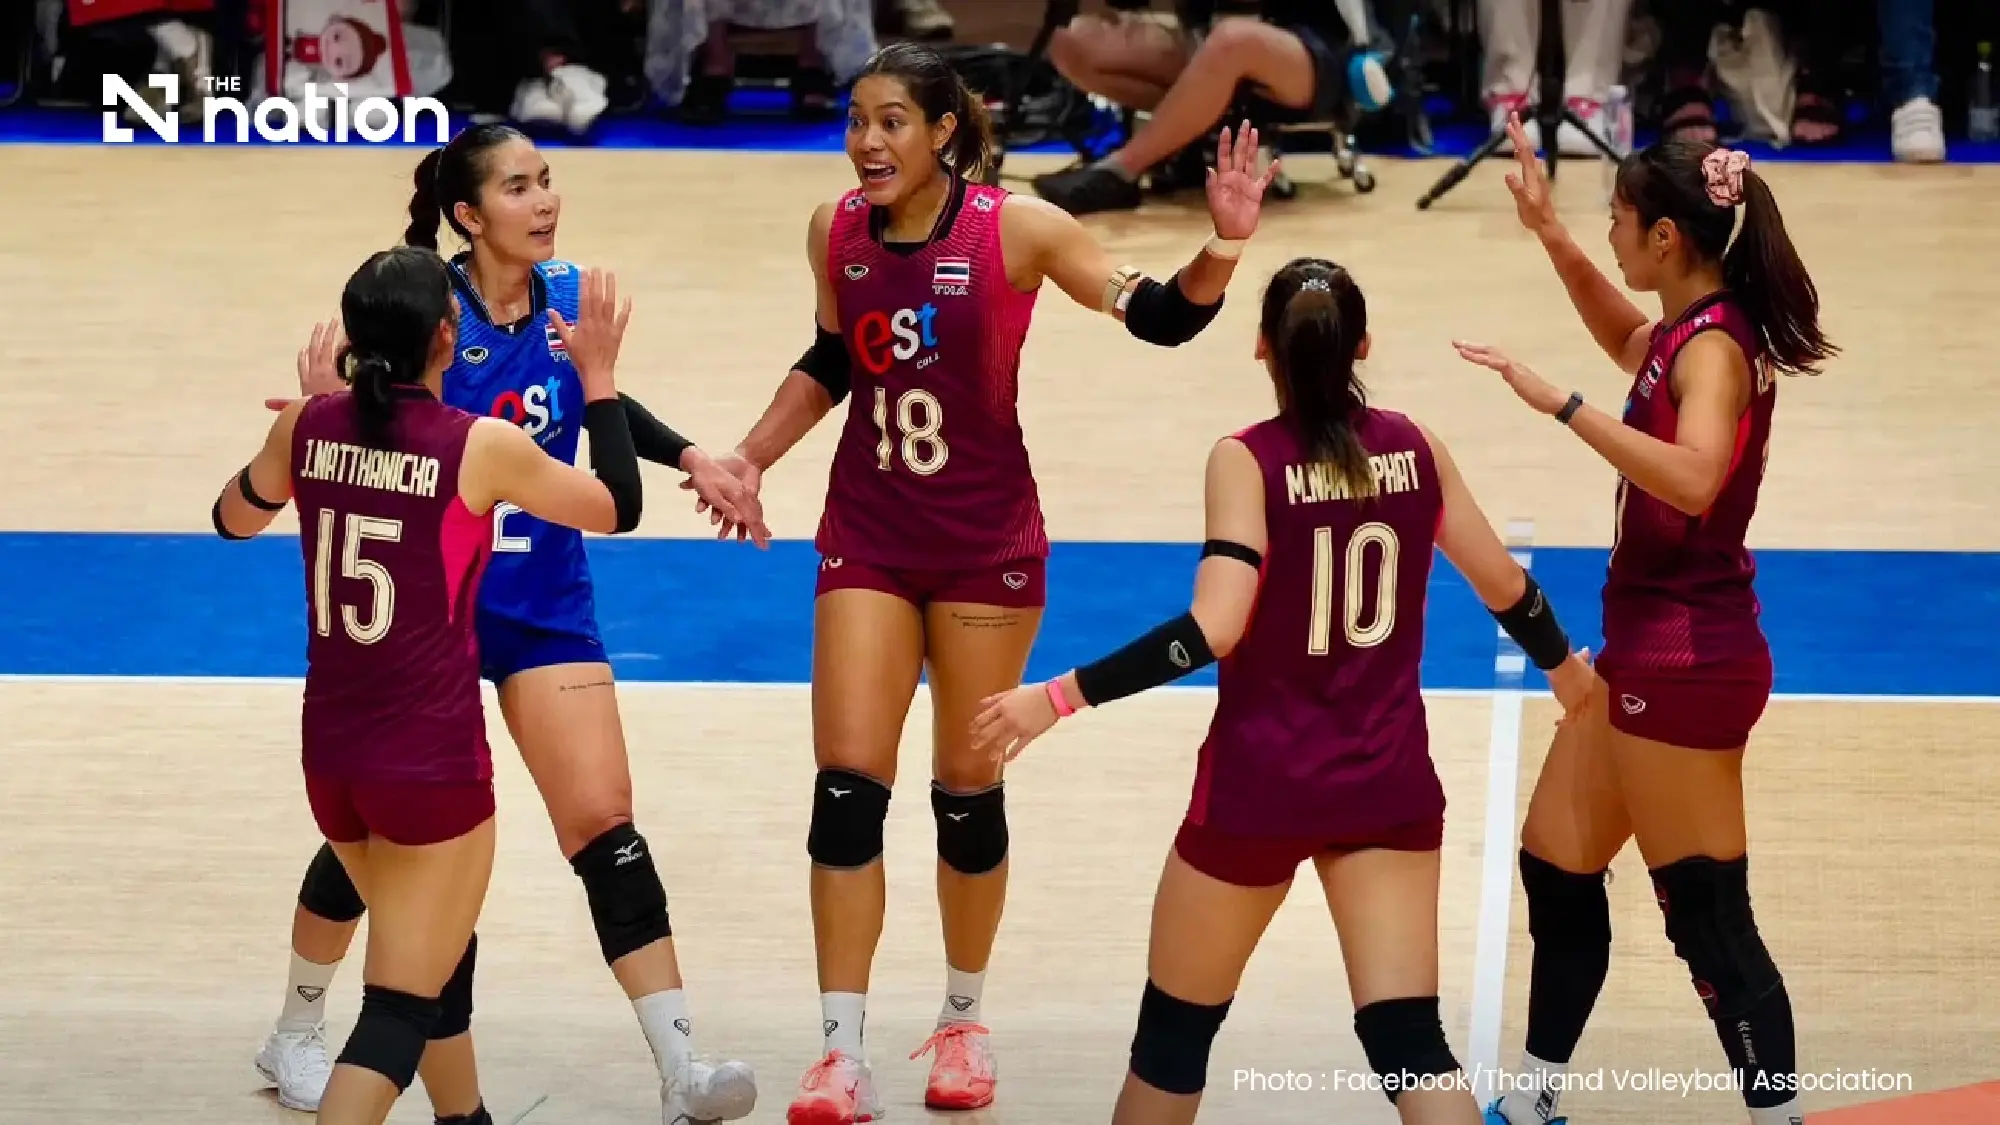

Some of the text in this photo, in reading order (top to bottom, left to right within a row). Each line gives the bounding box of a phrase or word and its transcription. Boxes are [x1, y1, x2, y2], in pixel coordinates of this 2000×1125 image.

[855, 302, 938, 375] est
[300, 439, 440, 498] J.NATTHANICHA
[873, 386, 949, 476] 18
[314, 508, 402, 645] 15
[1308, 521, 1400, 656] 10
